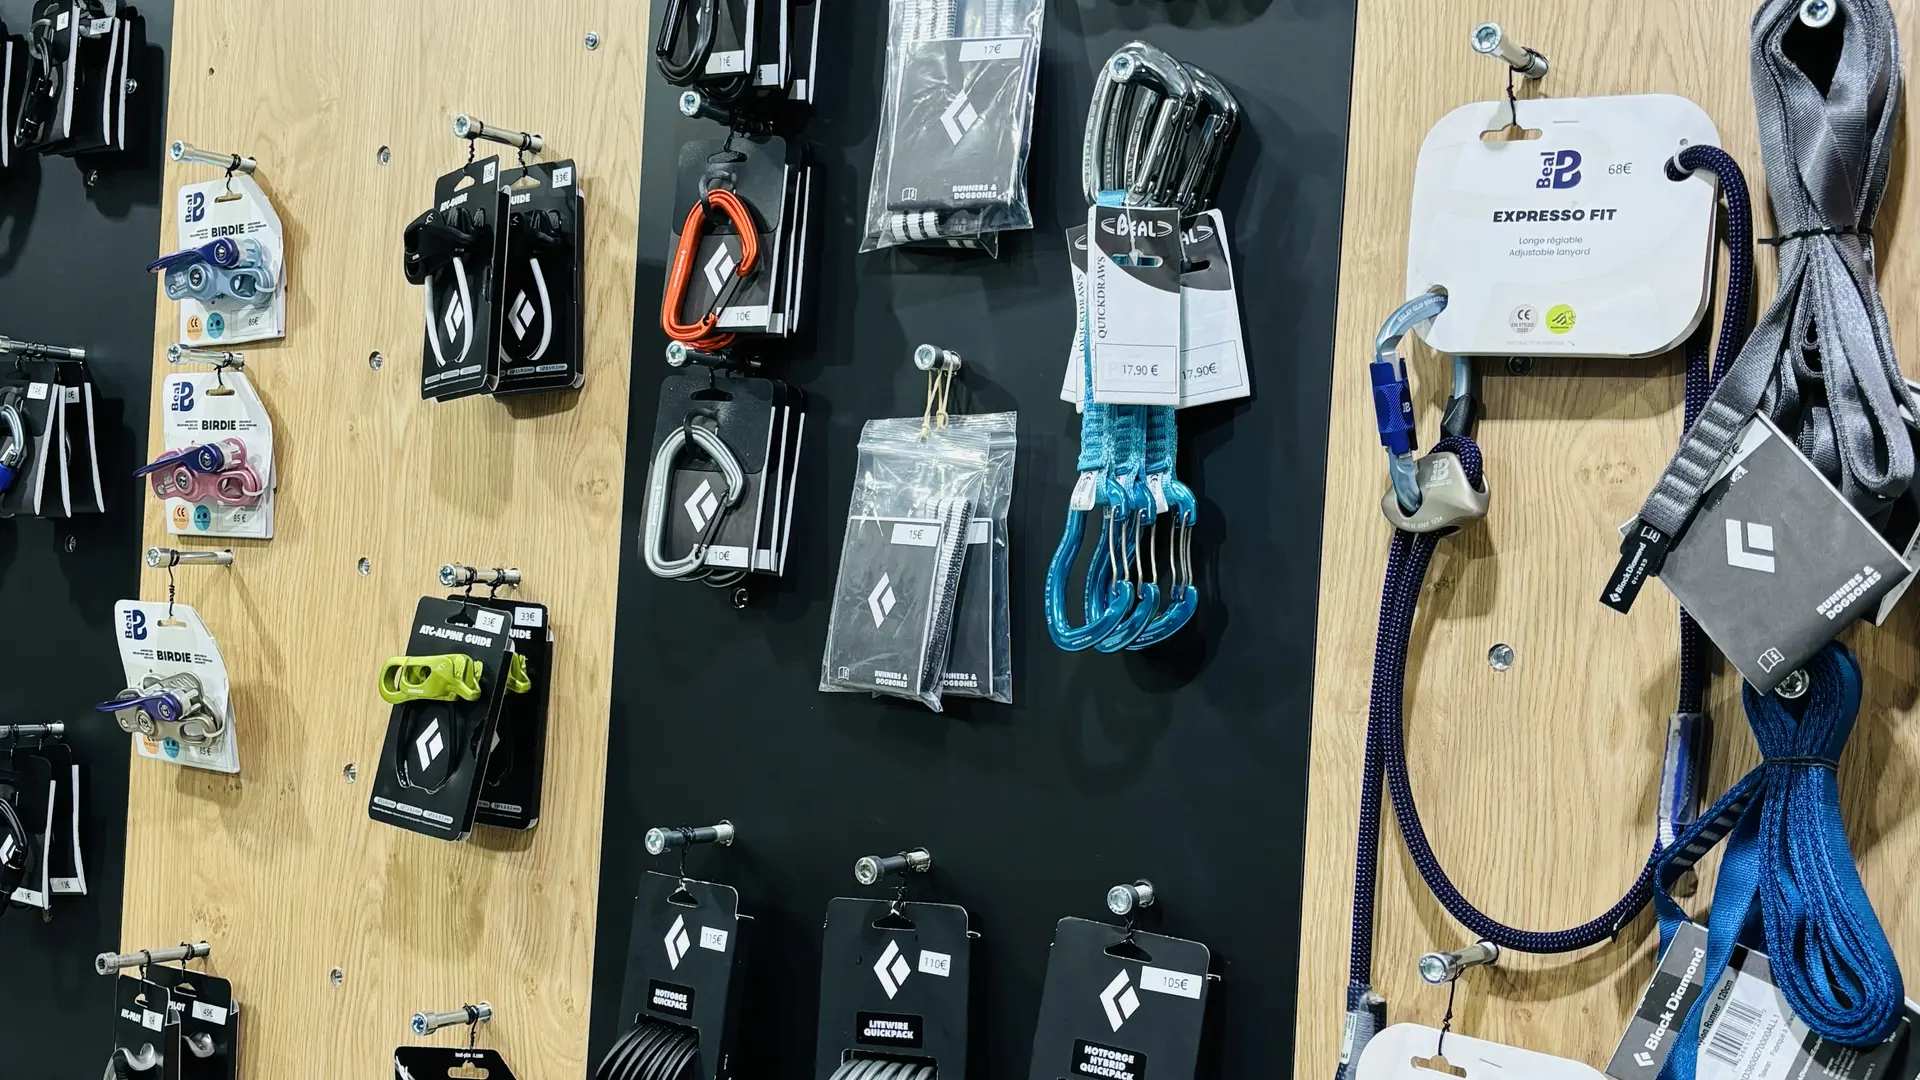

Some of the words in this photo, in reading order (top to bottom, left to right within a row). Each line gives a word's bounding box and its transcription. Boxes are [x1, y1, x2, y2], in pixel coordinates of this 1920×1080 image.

[983, 43, 1002, 55] 17€
[1536, 152, 1556, 189] Beal
[1607, 162, 1633, 175] 68€
[952, 184, 989, 193] RUNNERS
[990, 183, 997, 191] &
[510, 193, 531, 206] UIDE
[953, 191, 997, 200] DOGBONES
[184, 194, 193, 223] Beal
[1492, 208, 1586, 223] EXPRESSO
[1589, 208, 1618, 221] FIT
[211, 223, 245, 238] BIRDIE
[1116, 213, 1157, 238] BEAL
[1518, 236, 1545, 247] Longe
[1546, 235, 1583, 247] réglable
[1508, 248, 1555, 259] Adjustable
[1556, 247, 1591, 258] lanyard
[1097, 256, 1108, 339] QUICKDRAWS
[735, 311, 751, 322] 10€
[1122, 364, 1148, 376] 17,90
[1150, 364, 1159, 376] €
[171, 382, 180, 411] Beal
[201, 420, 237, 431] BIRDIE
[909, 529, 924, 540] 15€
[714, 550, 730, 561] 10€
[1614, 572, 1631, 595] Black
[1625, 542, 1647, 574] Diamond
[1816, 573, 1864, 616] RUNNERS
[1863, 565, 1875, 576] &
[1825, 570, 1882, 620] DOGBONES
[482, 616, 496, 628] 33€
[520, 611, 536, 622] 33€
[123, 610, 133, 639] Beal
[419, 624, 464, 642] ATC-ALPINE
[464, 632, 493, 648] GUIDE
[509, 629, 532, 640] UIDE
[156, 650, 192, 663] BIRDIE
[874, 670, 902, 680] RUNNERS
[902, 673, 908, 681] &
[875, 677, 908, 688] DOGBONES
[705, 932, 723, 946] 115€
[924, 957, 948, 971] 110€
[1163, 976, 1189, 991] 105€
[655, 988, 688, 1003] HOTFORGE
[1644, 1009, 1675, 1051] Black
[1665, 947, 1706, 1011] Diamond
[653, 996, 688, 1011] QUICKPACK
[1703, 1003, 1721, 1028] Runner
[1717, 979, 1734, 1001] 120cm
[869, 1020, 909, 1030] LITEWIRE
[863, 1028, 914, 1039] QUICKPACK
[1741, 1014, 1780, 1080] D3800270000ALL1
[1084, 1045, 1135, 1064] HOTFORGE
[1089, 1055, 1126, 1072] HYBRID
[1079, 1062, 1135, 1080] QUICKPACK
